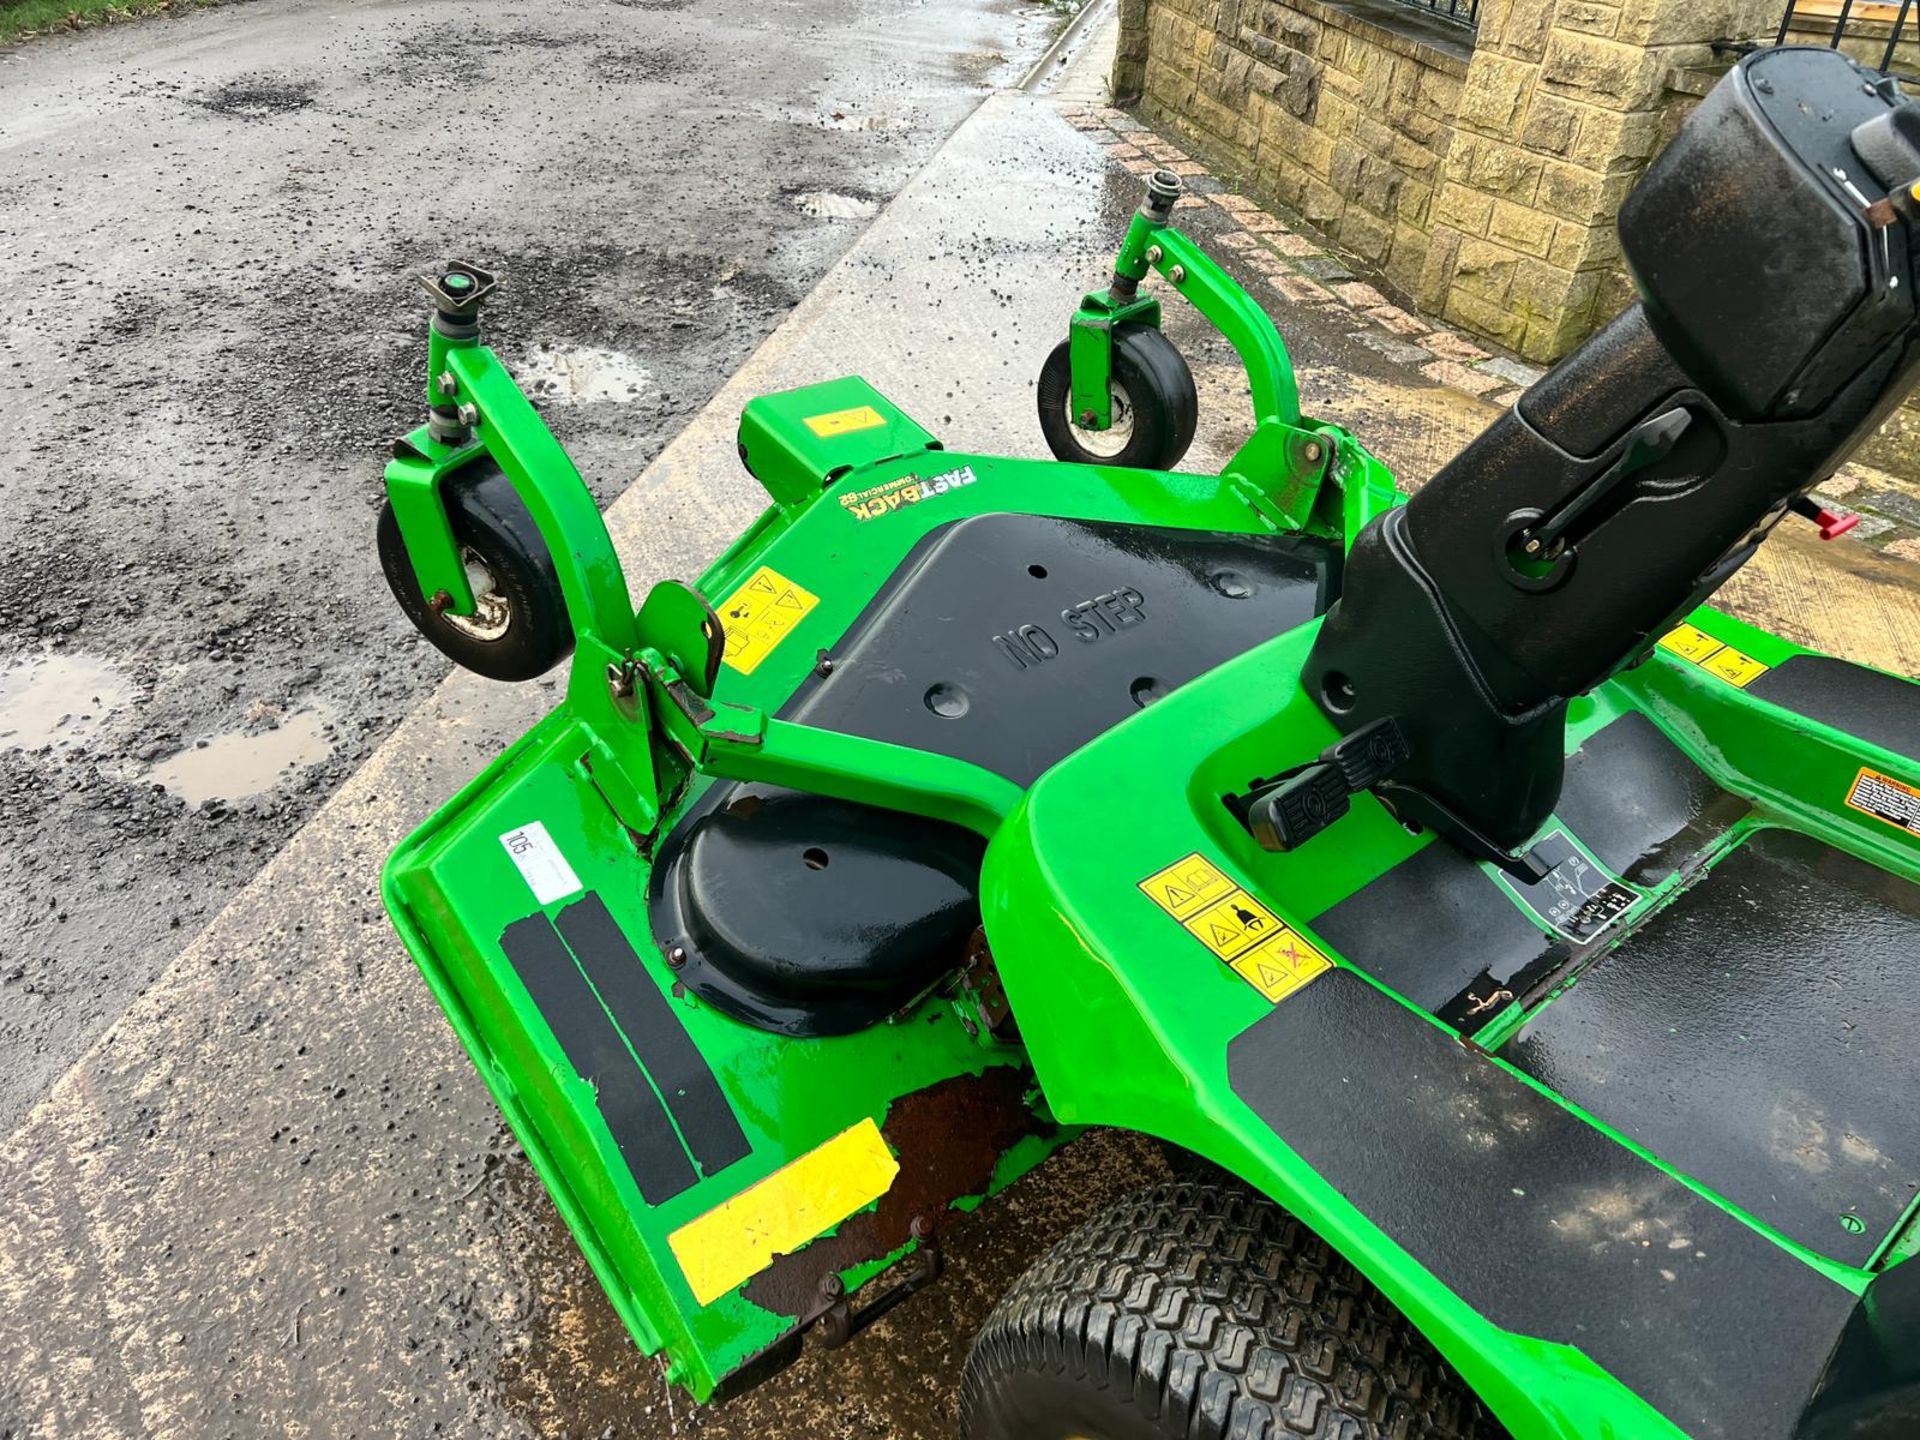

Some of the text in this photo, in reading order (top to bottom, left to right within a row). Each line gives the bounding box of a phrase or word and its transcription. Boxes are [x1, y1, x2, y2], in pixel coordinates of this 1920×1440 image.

[992, 586, 1146, 669] NO STEP
[506, 831, 533, 854] 105
